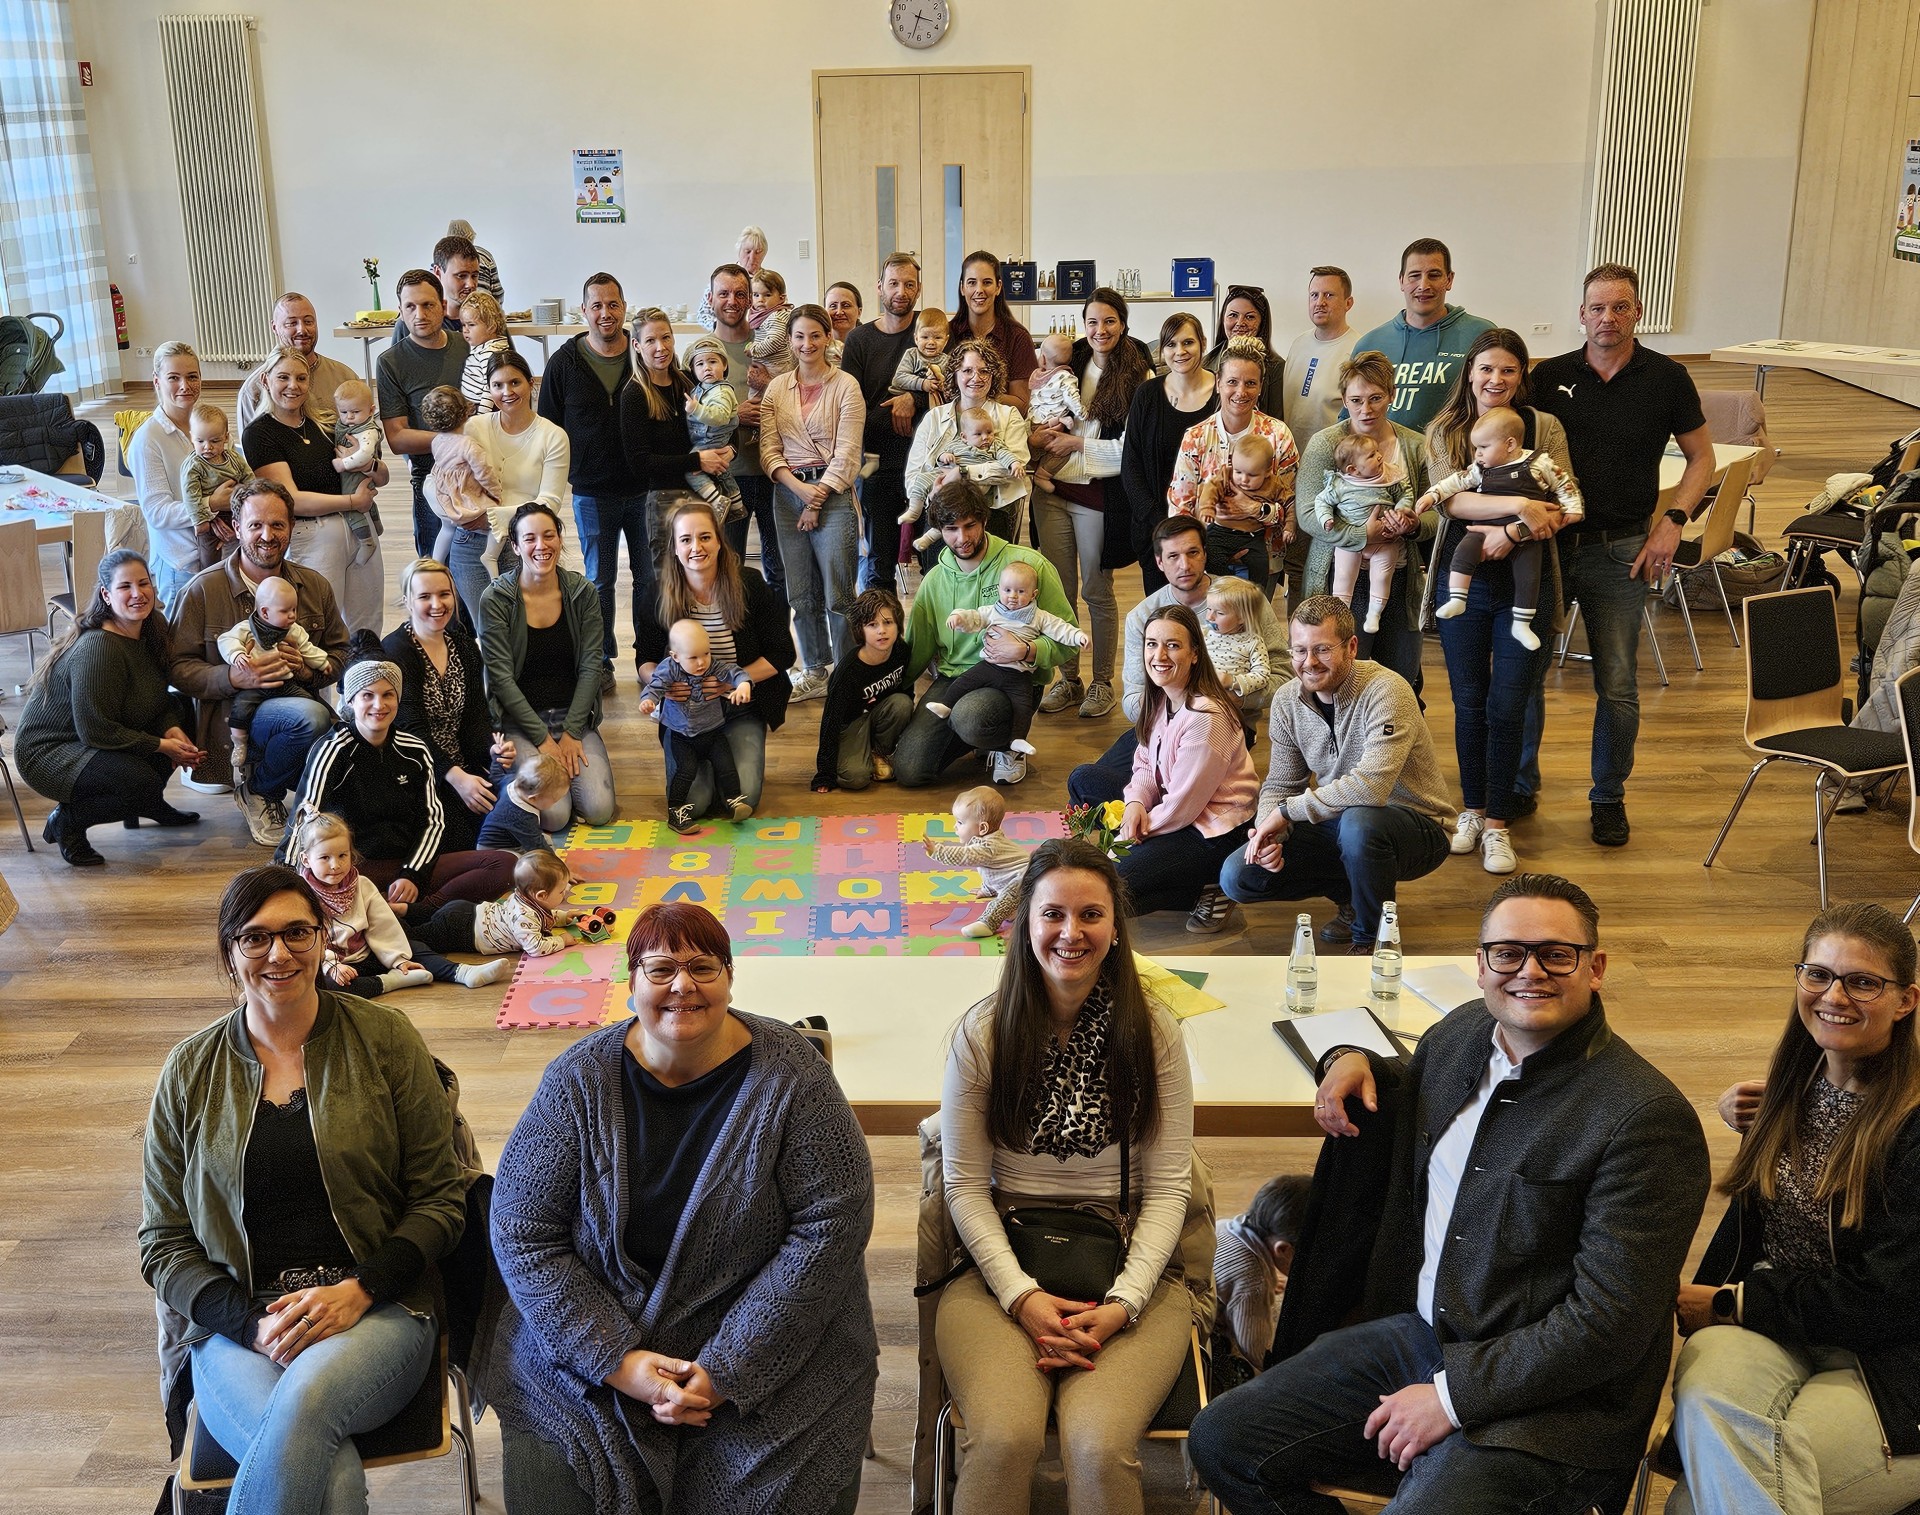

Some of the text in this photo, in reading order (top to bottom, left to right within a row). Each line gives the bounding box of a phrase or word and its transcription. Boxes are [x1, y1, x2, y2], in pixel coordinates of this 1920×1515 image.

[926, 31, 931, 39] 5
[1392, 361, 1452, 385] REAK
[1387, 387, 1420, 412] UT
[668, 851, 712, 872] 8
[928, 875, 969, 897] X
[528, 987, 590, 1016] C
